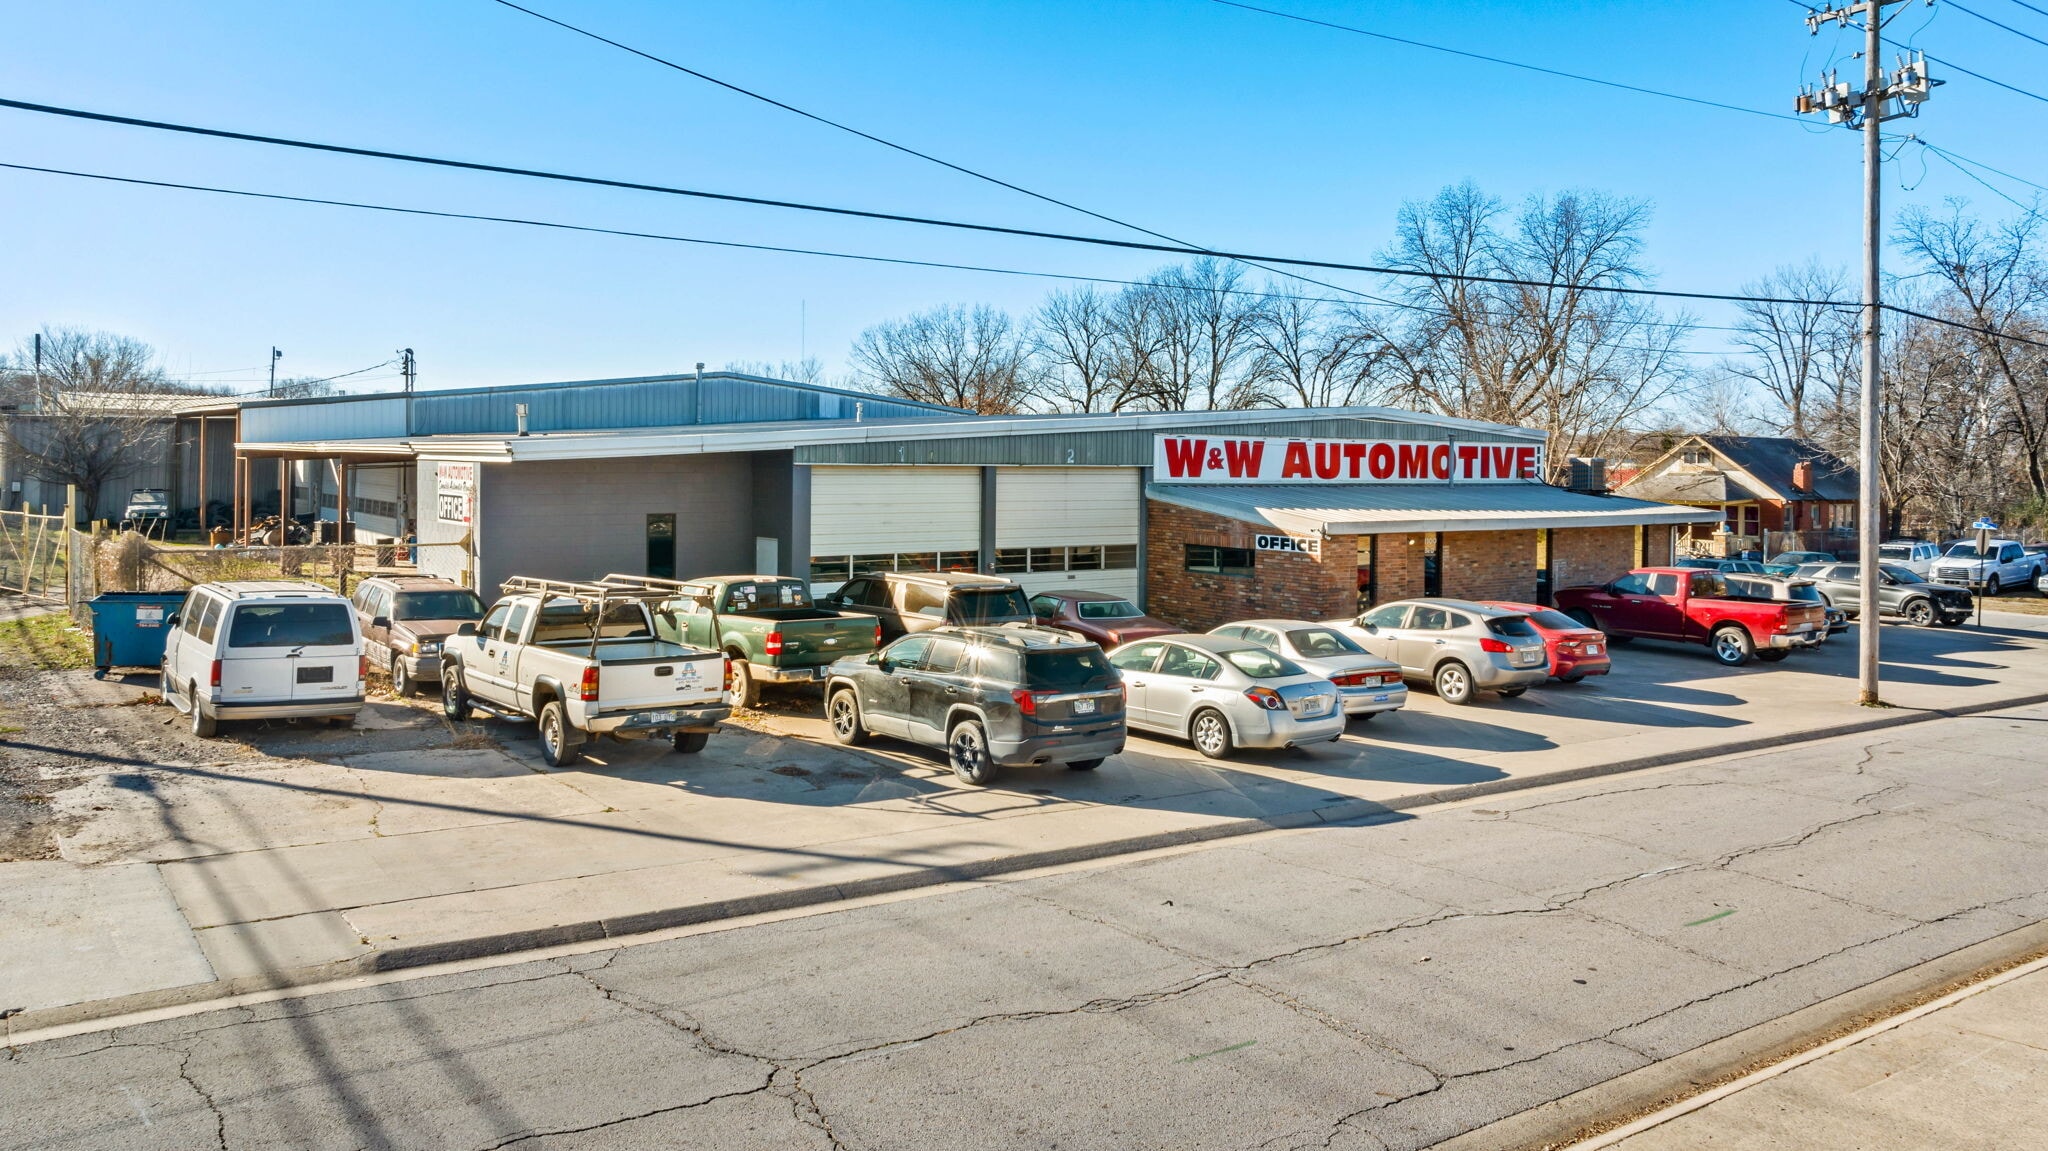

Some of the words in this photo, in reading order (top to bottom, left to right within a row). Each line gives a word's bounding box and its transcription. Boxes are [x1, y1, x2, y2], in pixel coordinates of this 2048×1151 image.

[1066, 448, 1076, 464] 2
[1164, 438, 1265, 478] W&W
[1281, 441, 1536, 481] AUTOMOTIVE
[439, 495, 463, 521] OFFICE
[1257, 535, 1319, 553] OFFICE
